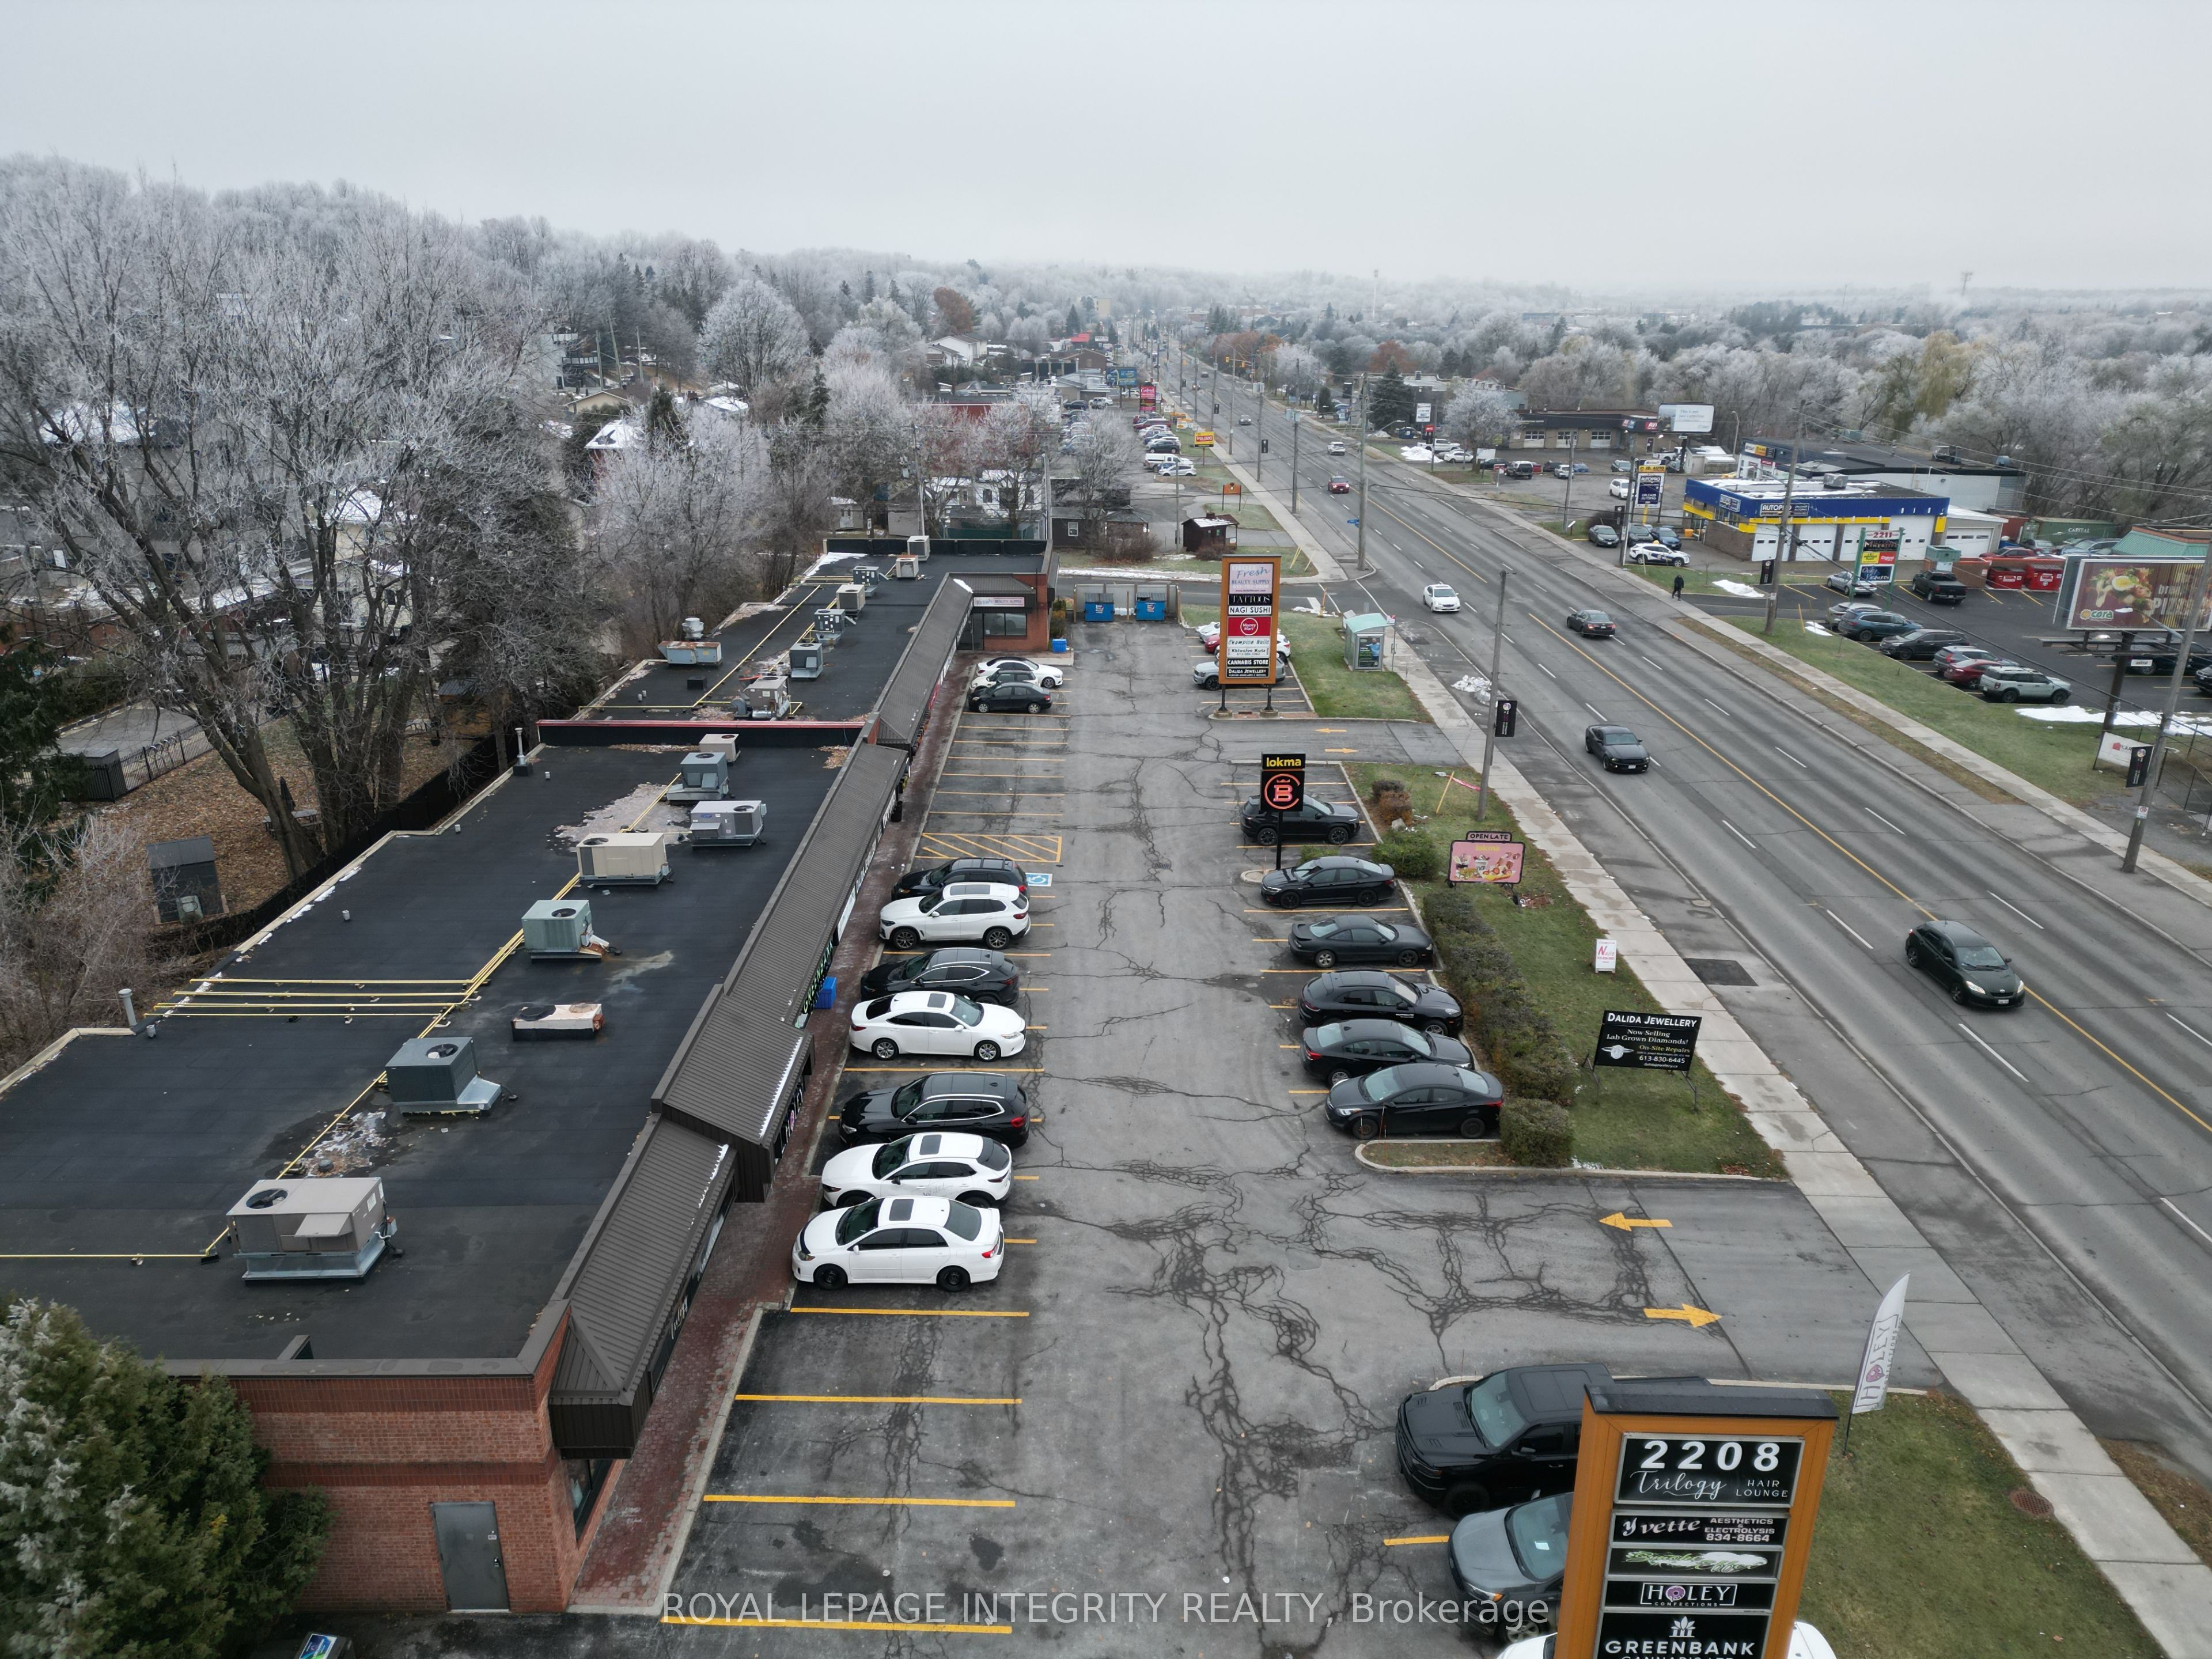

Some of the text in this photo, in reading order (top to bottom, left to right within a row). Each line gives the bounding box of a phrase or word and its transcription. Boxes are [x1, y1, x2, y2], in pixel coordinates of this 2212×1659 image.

[1237, 567, 1271, 579] Fresh
[1232, 595, 1270, 603] TATTOOS
[2090, 611, 2113, 619] cora
[1266, 757, 1302, 767] lokma
[1607, 1013, 1697, 1027] DALIDA JEWELLERY
[1645, 1030, 1671, 1038] Selling
[1665, 1046, 1691, 1054] Repairs
[1639, 1055, 1685, 1063] 613-830-6445
[1641, 1440, 1780, 1472] 2208
[1630, 1470, 1728, 1500] Trilogy
[1736, 1489, 1789, 1498] LOUNGE
[1622, 1517, 1701, 1536] Yvette
[1706, 1533, 1770, 1542] 834-8664
[1647, 1585, 1731, 1602] HOLEY
[1605, 1641, 1755, 1656] GREENBANK
